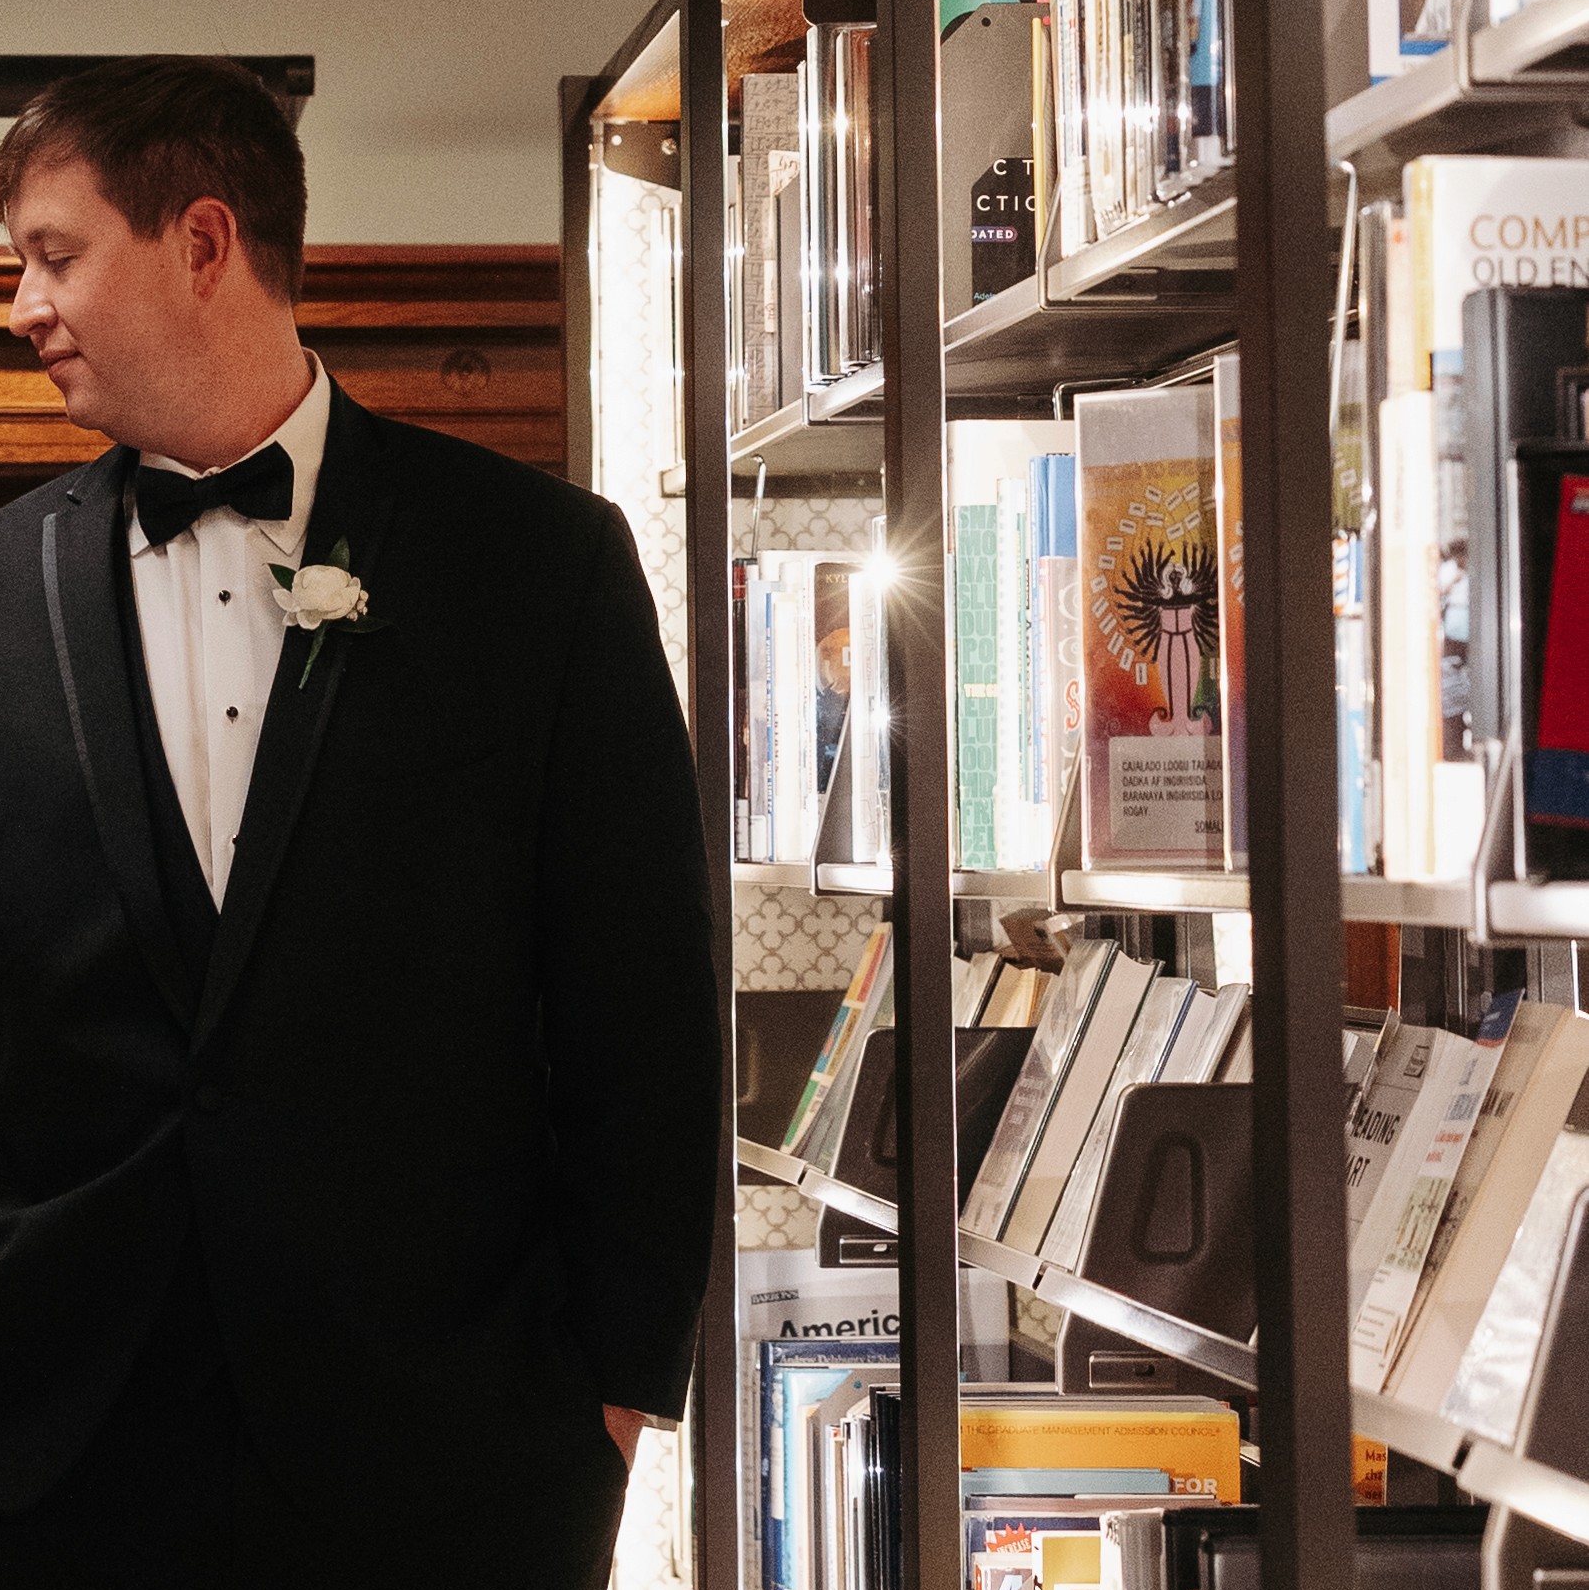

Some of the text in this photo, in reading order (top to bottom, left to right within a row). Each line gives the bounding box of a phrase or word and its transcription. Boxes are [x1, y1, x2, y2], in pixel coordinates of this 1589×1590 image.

[1473, 256, 1538, 286] OLD
[1352, 1108, 1401, 1146] EADING
[988, 1424, 1038, 1436] GRADUATE
[1042, 1424, 1110, 1436] MANAGEMENT
[1114, 1424, 1168, 1436] ADMISSION
[1173, 1477, 1218, 1494] FOR
